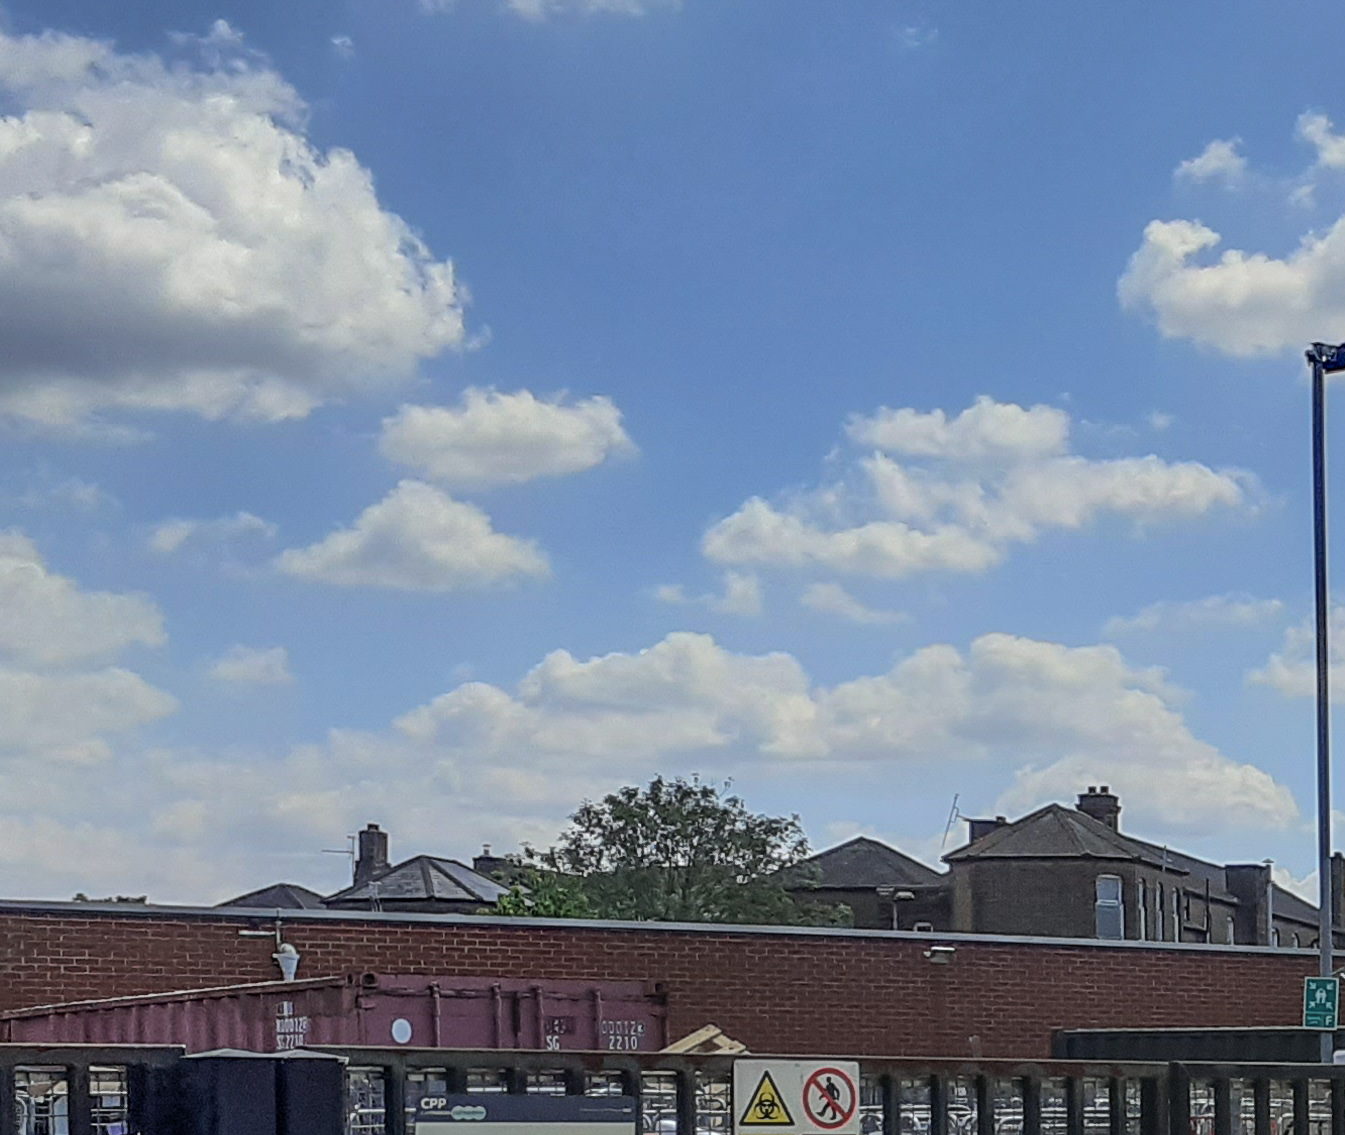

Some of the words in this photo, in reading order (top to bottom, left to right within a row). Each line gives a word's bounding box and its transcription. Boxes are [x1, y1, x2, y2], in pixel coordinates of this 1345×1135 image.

[1325, 1015, 1333, 1026] F
[546, 1036, 560, 1050] SG
[609, 1036, 638, 1050] 2210
[420, 1097, 447, 1109] CPP
